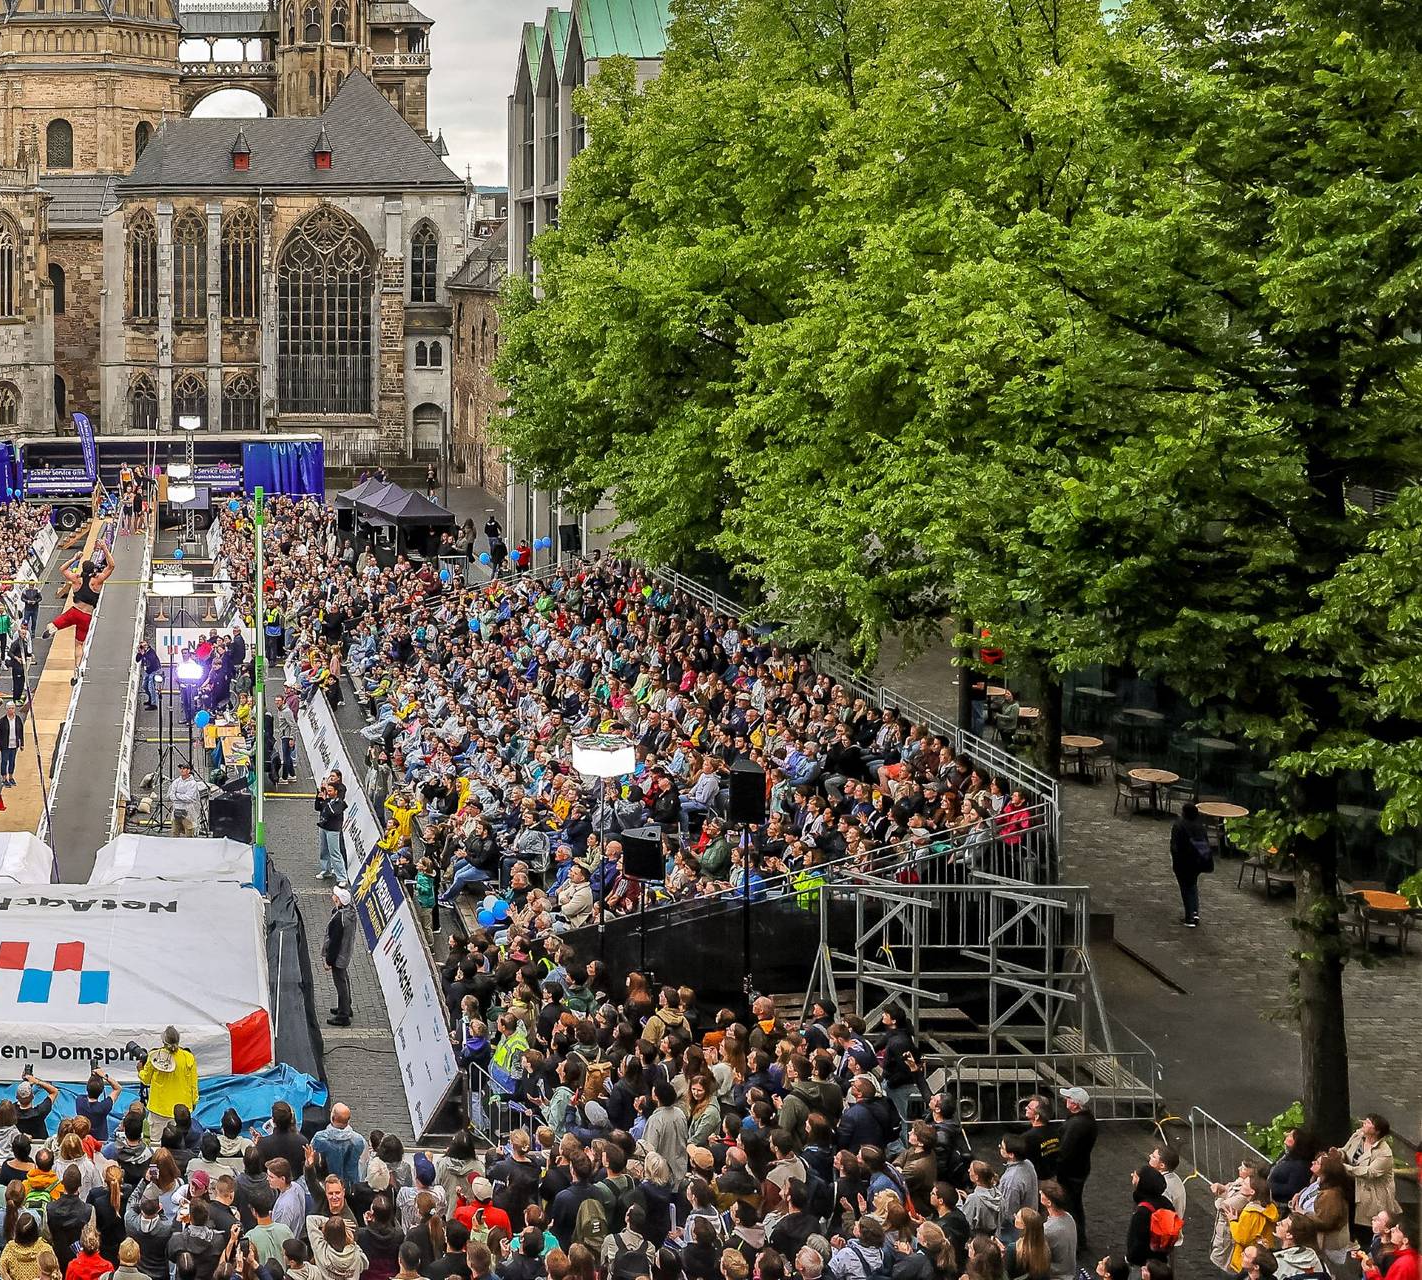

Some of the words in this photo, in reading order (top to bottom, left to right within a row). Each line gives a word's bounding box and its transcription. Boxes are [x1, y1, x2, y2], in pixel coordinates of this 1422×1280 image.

[349, 818, 368, 865] NetAachen
[374, 875, 396, 922] MERKUR
[392, 941, 415, 1008] NetAachen
